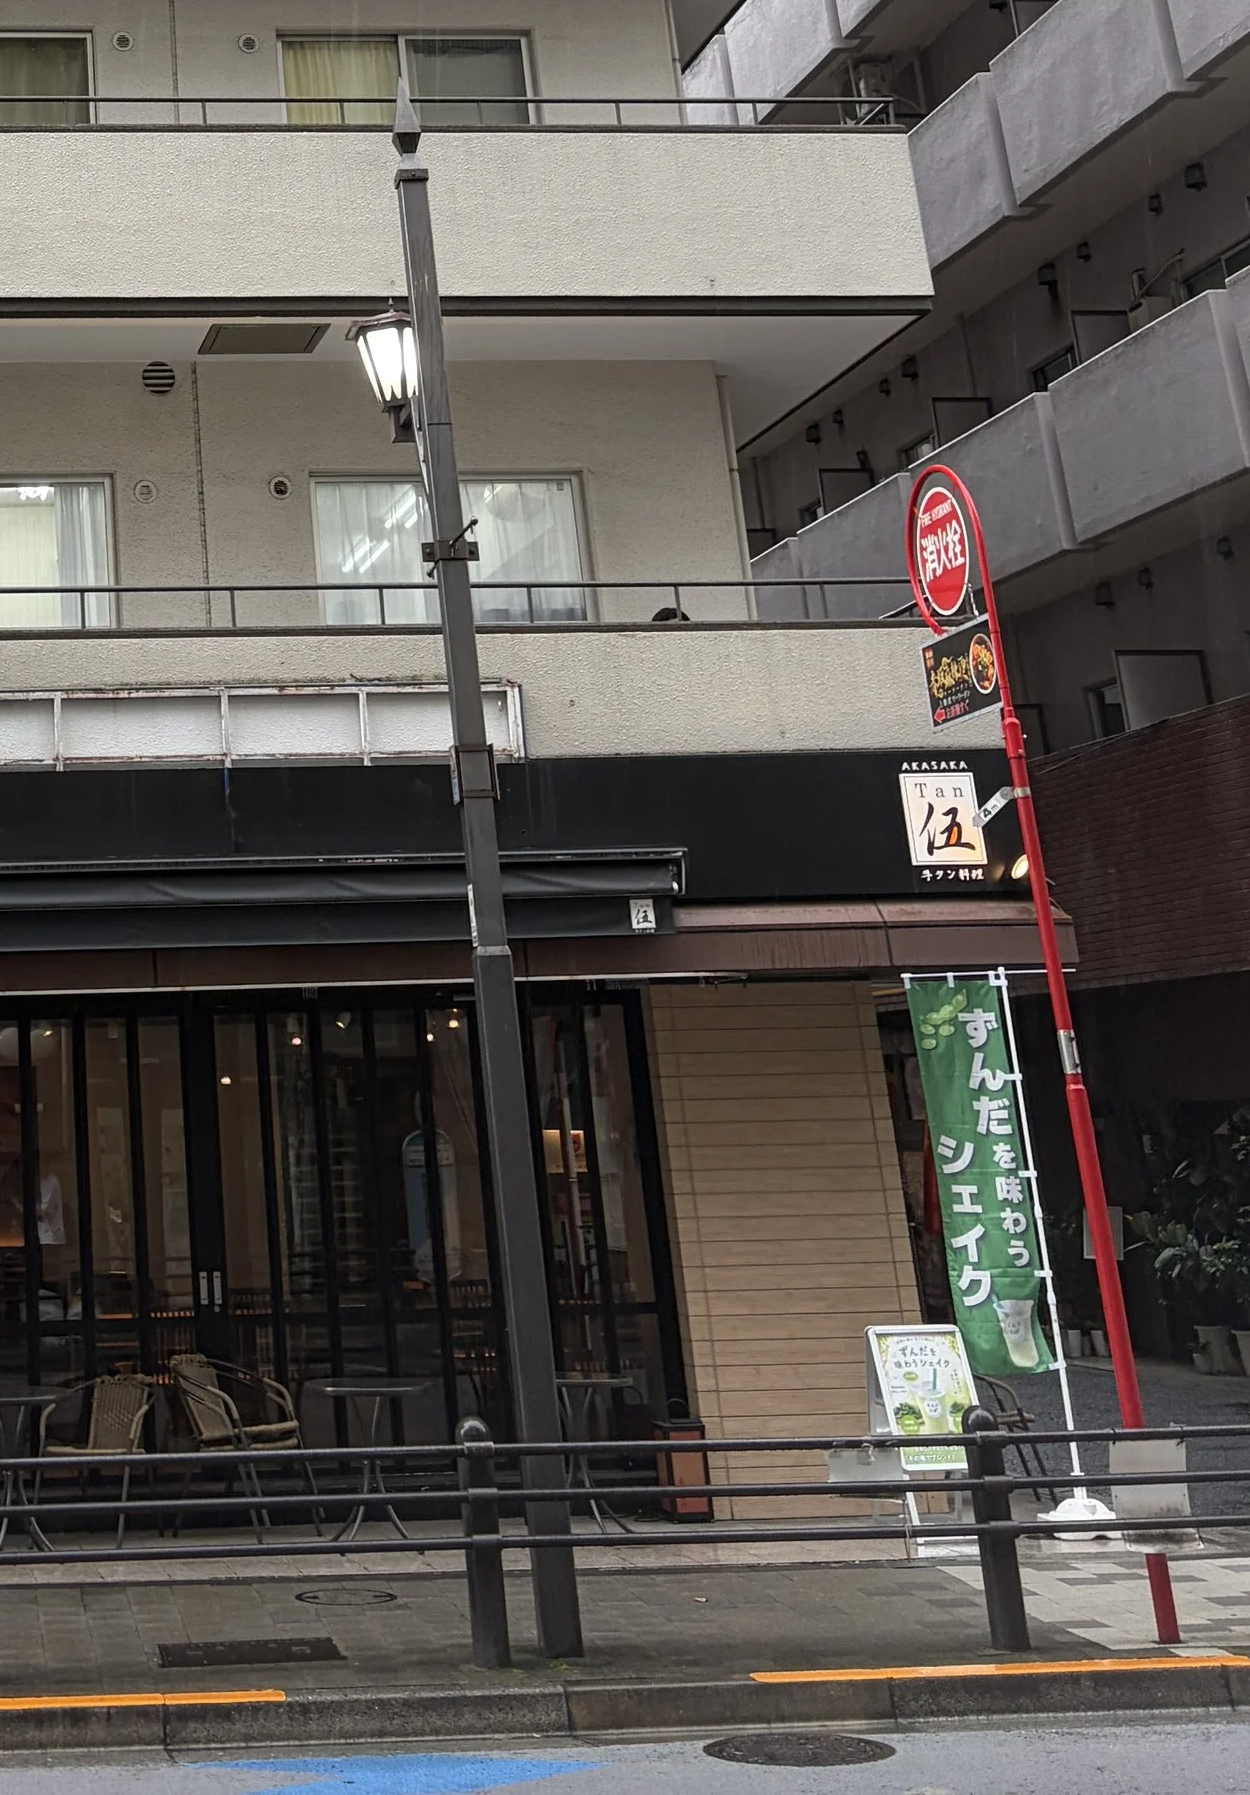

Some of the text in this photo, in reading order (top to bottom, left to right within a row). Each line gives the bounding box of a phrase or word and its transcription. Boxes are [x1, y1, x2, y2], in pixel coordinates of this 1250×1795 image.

[921, 520, 965, 582] 消火栓
[901, 761, 968, 771] AKASAKA
[914, 782, 965, 798] Tan
[981, 803, 999, 819] 4m
[918, 801, 976, 856] 伍
[920, 868, 985, 881] 牛タン料理
[957, 1007, 1031, 1268] ずんだを味わう
[937, 1134, 992, 1307] シェイク
[898, 1345, 937, 1357] ずんだを
